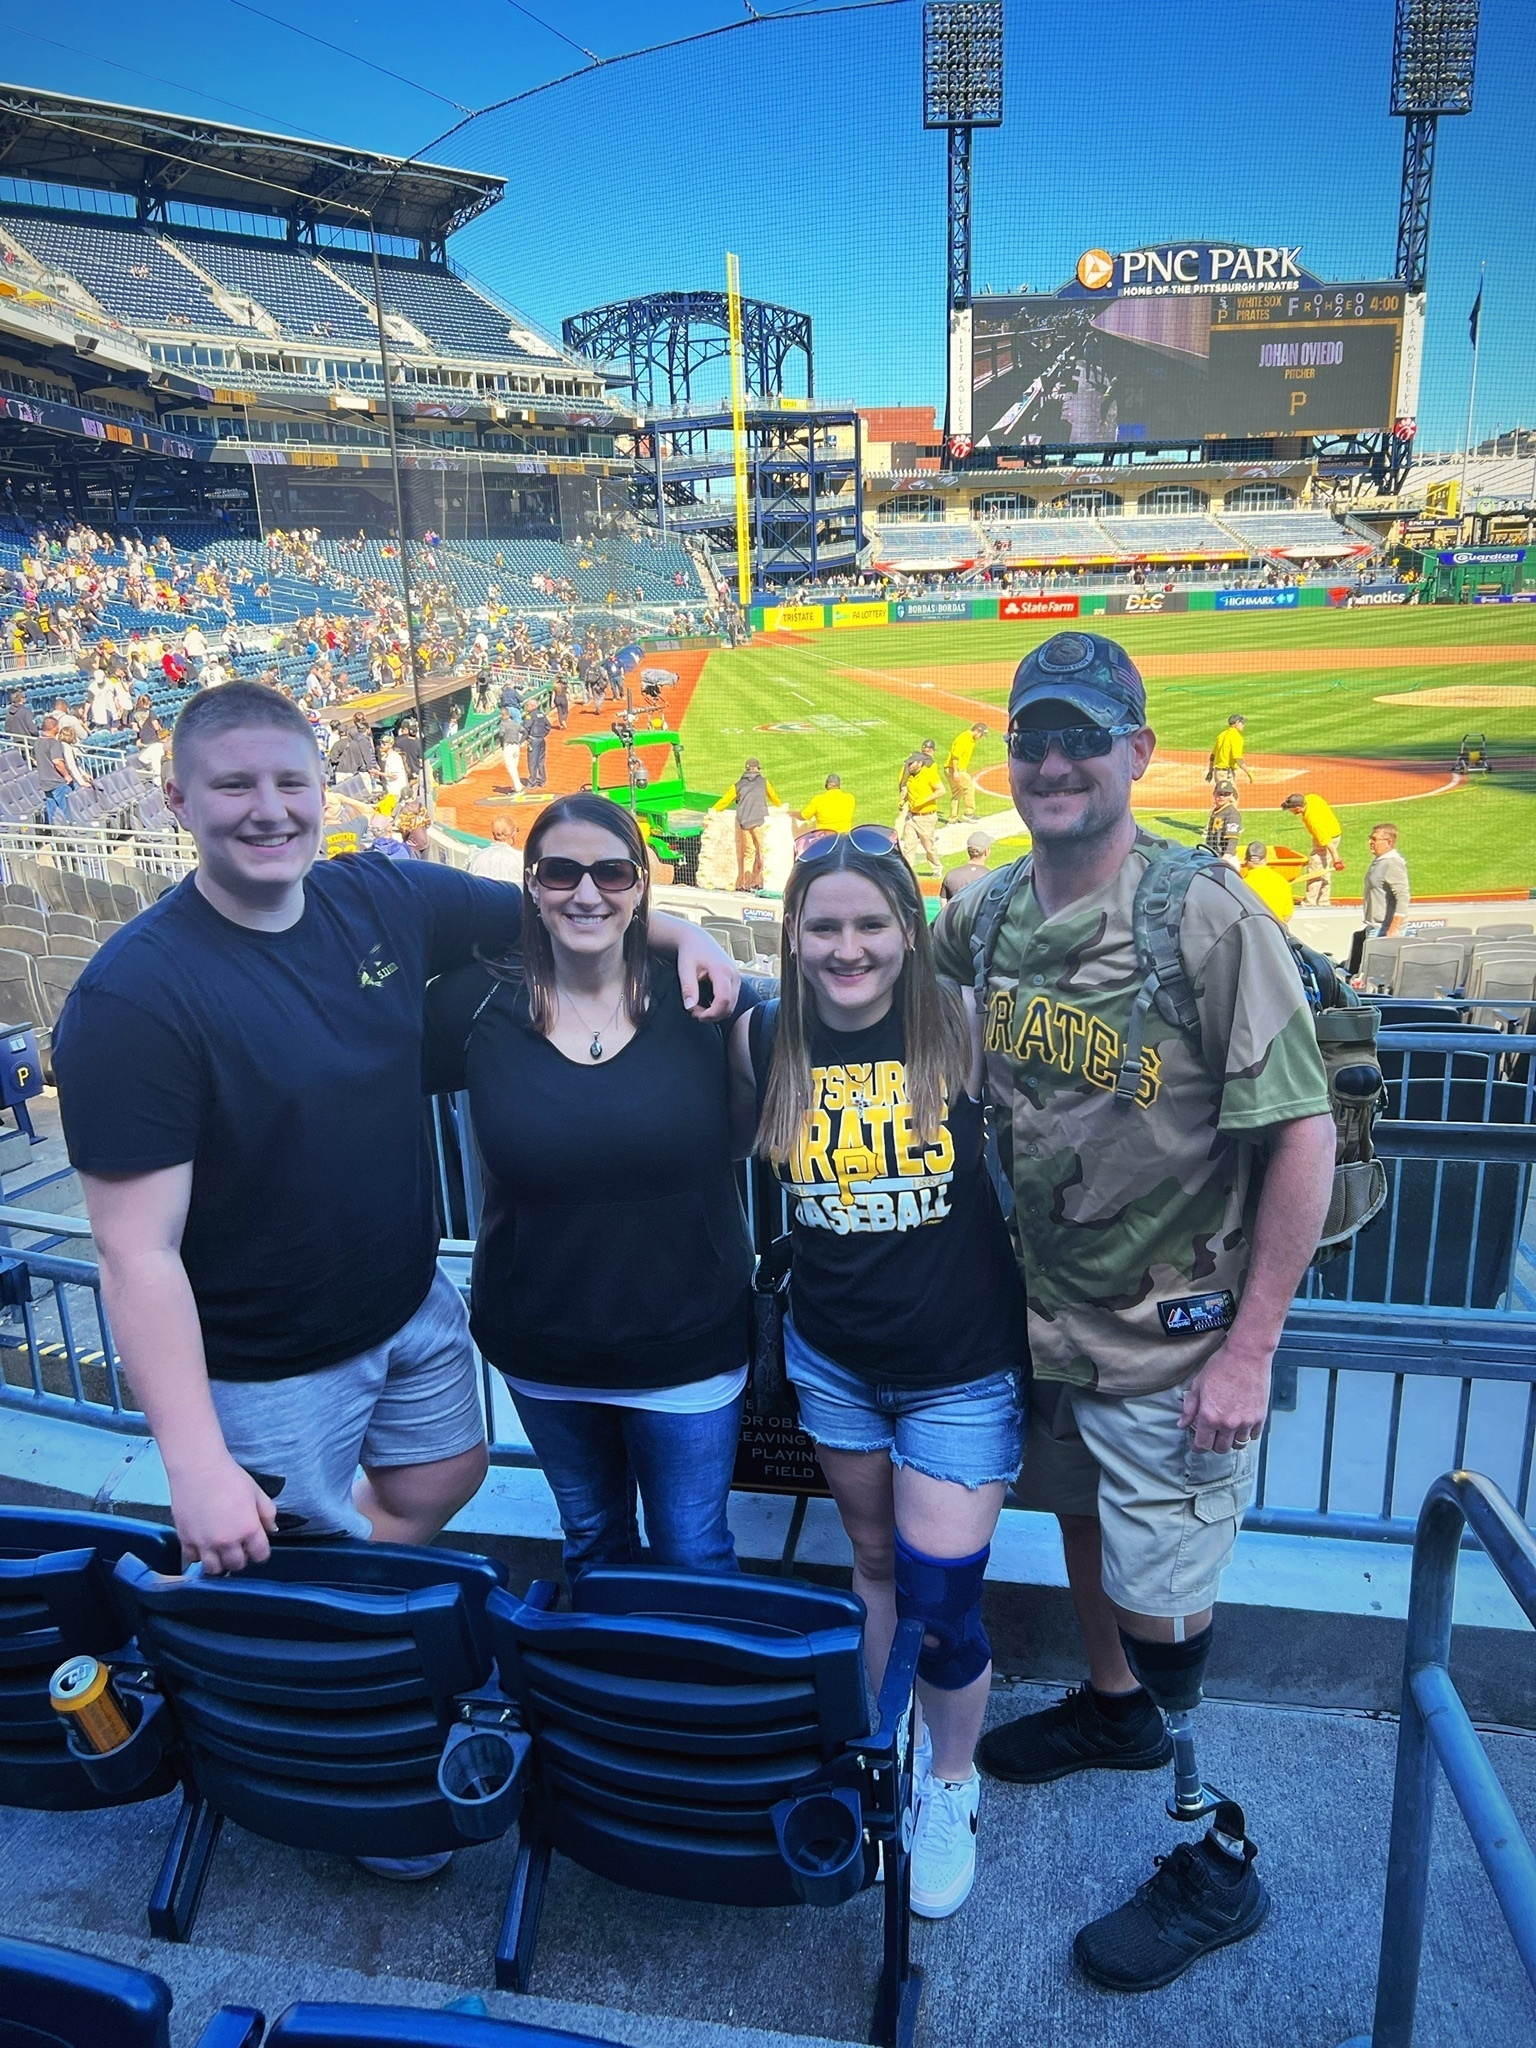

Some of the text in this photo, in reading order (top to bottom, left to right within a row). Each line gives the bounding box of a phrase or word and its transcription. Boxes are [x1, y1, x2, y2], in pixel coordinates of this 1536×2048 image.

[1120, 246, 1303, 284] PNC PARK
[1123, 280, 1300, 297] HOME OF THE PITTSBURGH PIRATES
[1237, 295, 1282, 308] WHITE SOX
[1335, 293, 1344, 305] 6
[1346, 300, 1353, 310] E
[1370, 295, 1400, 312] 4:00
[1288, 297, 1299, 317] F
[1304, 303, 1311, 312] R
[1325, 302, 1333, 310] H
[1334, 307, 1343, 318] 2
[1236, 309, 1270, 321] PIRATES
[1259, 341, 1344, 368] JOHAN OVIEDO
[1285, 368, 1316, 380] PITCHER
[1453, 552, 1517, 565] Guardian
[1125, 594, 1165, 611] DLC
[1224, 594, 1274, 607] HIGHMARK
[1353, 591, 1405, 605] anatics
[861, 609, 886, 619] LOTTERY
[907, 603, 965, 615] BORDAS BORDAS
[782, 612, 814, 623] TRISTATE
[743, 908, 774, 918] CAUTION
[738, 1431, 806, 1446] EAVING
[764, 1465, 815, 1479] FIELD
